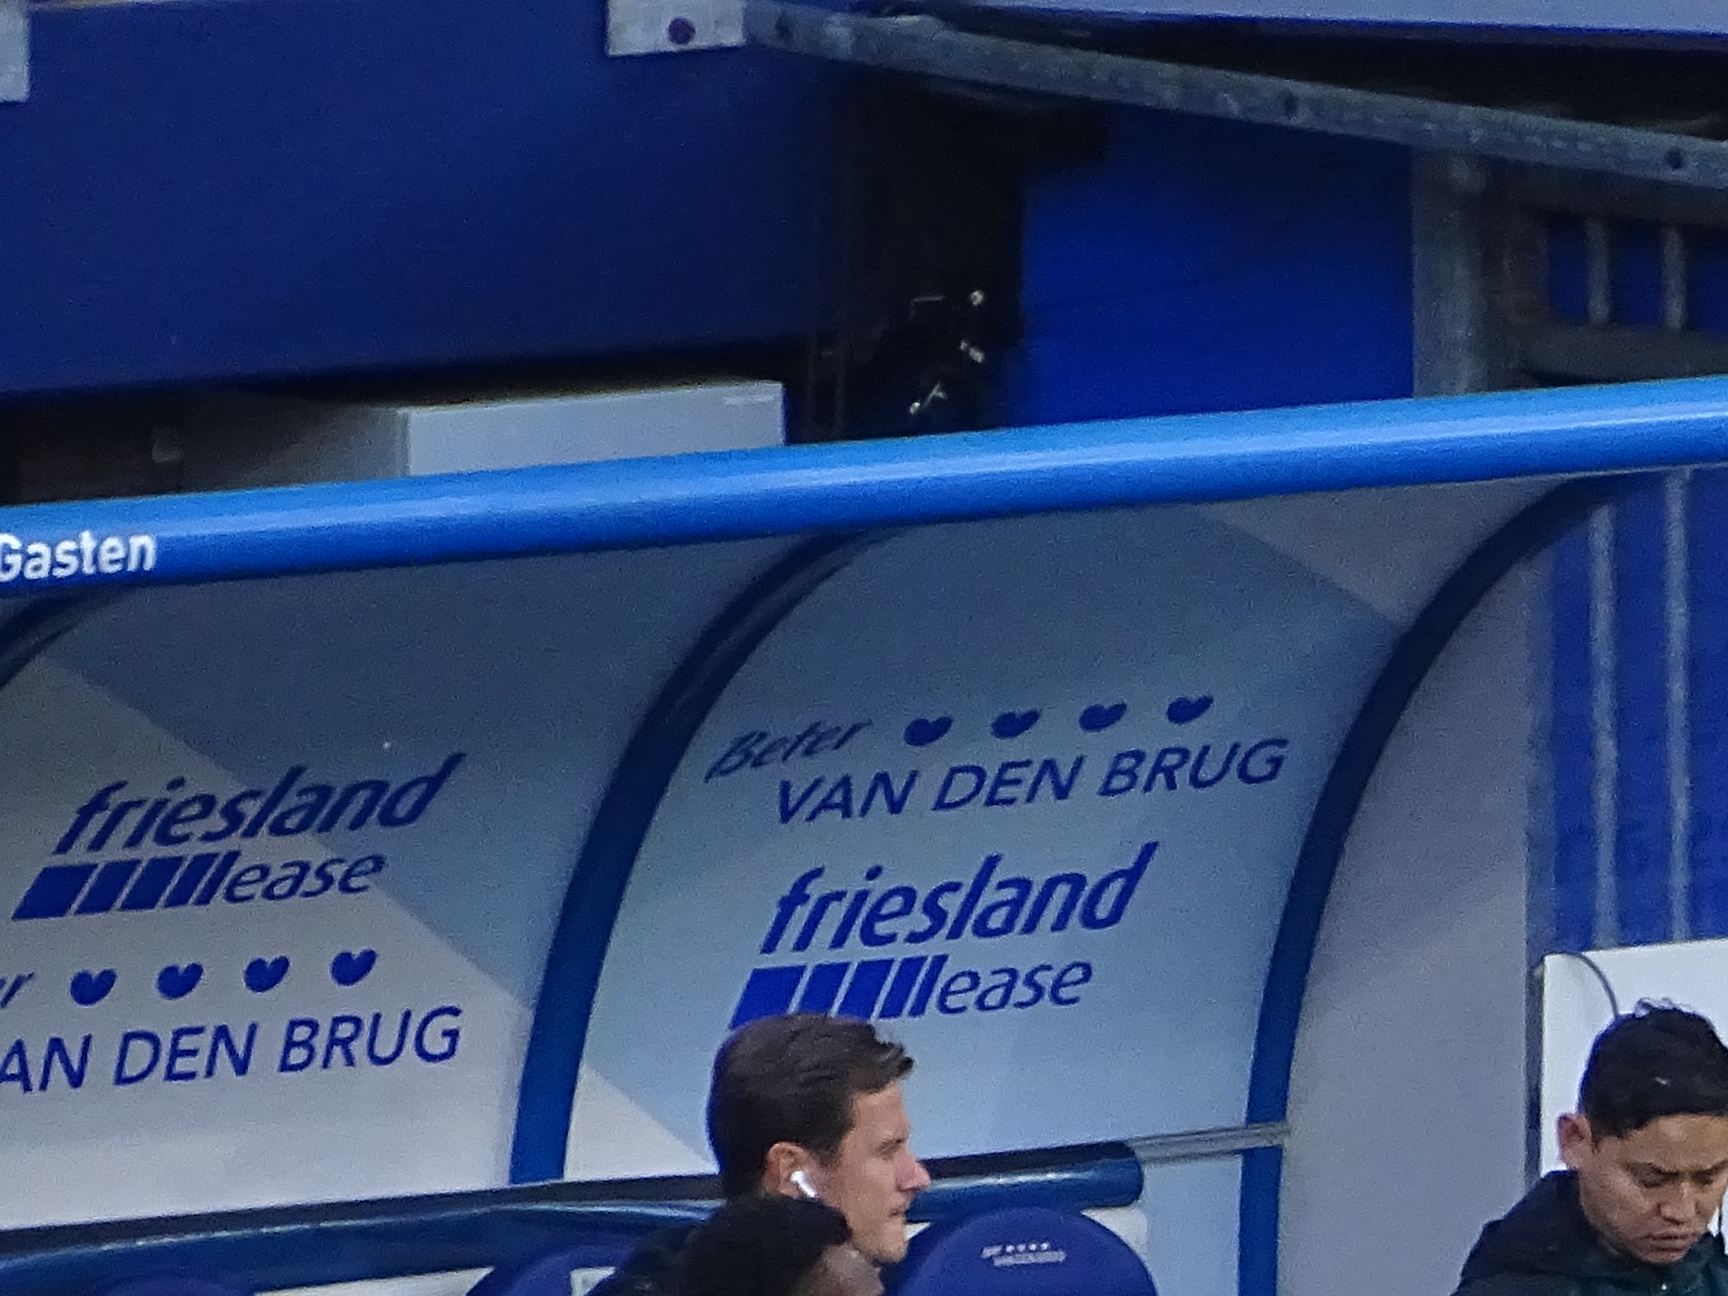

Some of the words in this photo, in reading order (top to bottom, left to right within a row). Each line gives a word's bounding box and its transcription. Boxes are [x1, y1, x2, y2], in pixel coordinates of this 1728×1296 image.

[0, 528, 158, 584] Gasten
[703, 715, 876, 784] Beter
[776, 769, 920, 825] VAN
[930, 754, 1087, 812] DEN
[1096, 737, 1290, 799] BRUG
[52, 751, 467, 856] friesland
[758, 840, 1160, 956] friesland
[0, 1031, 93, 1094] AN
[113, 1020, 258, 1087] DEN
[277, 1004, 465, 1075] BRUG
